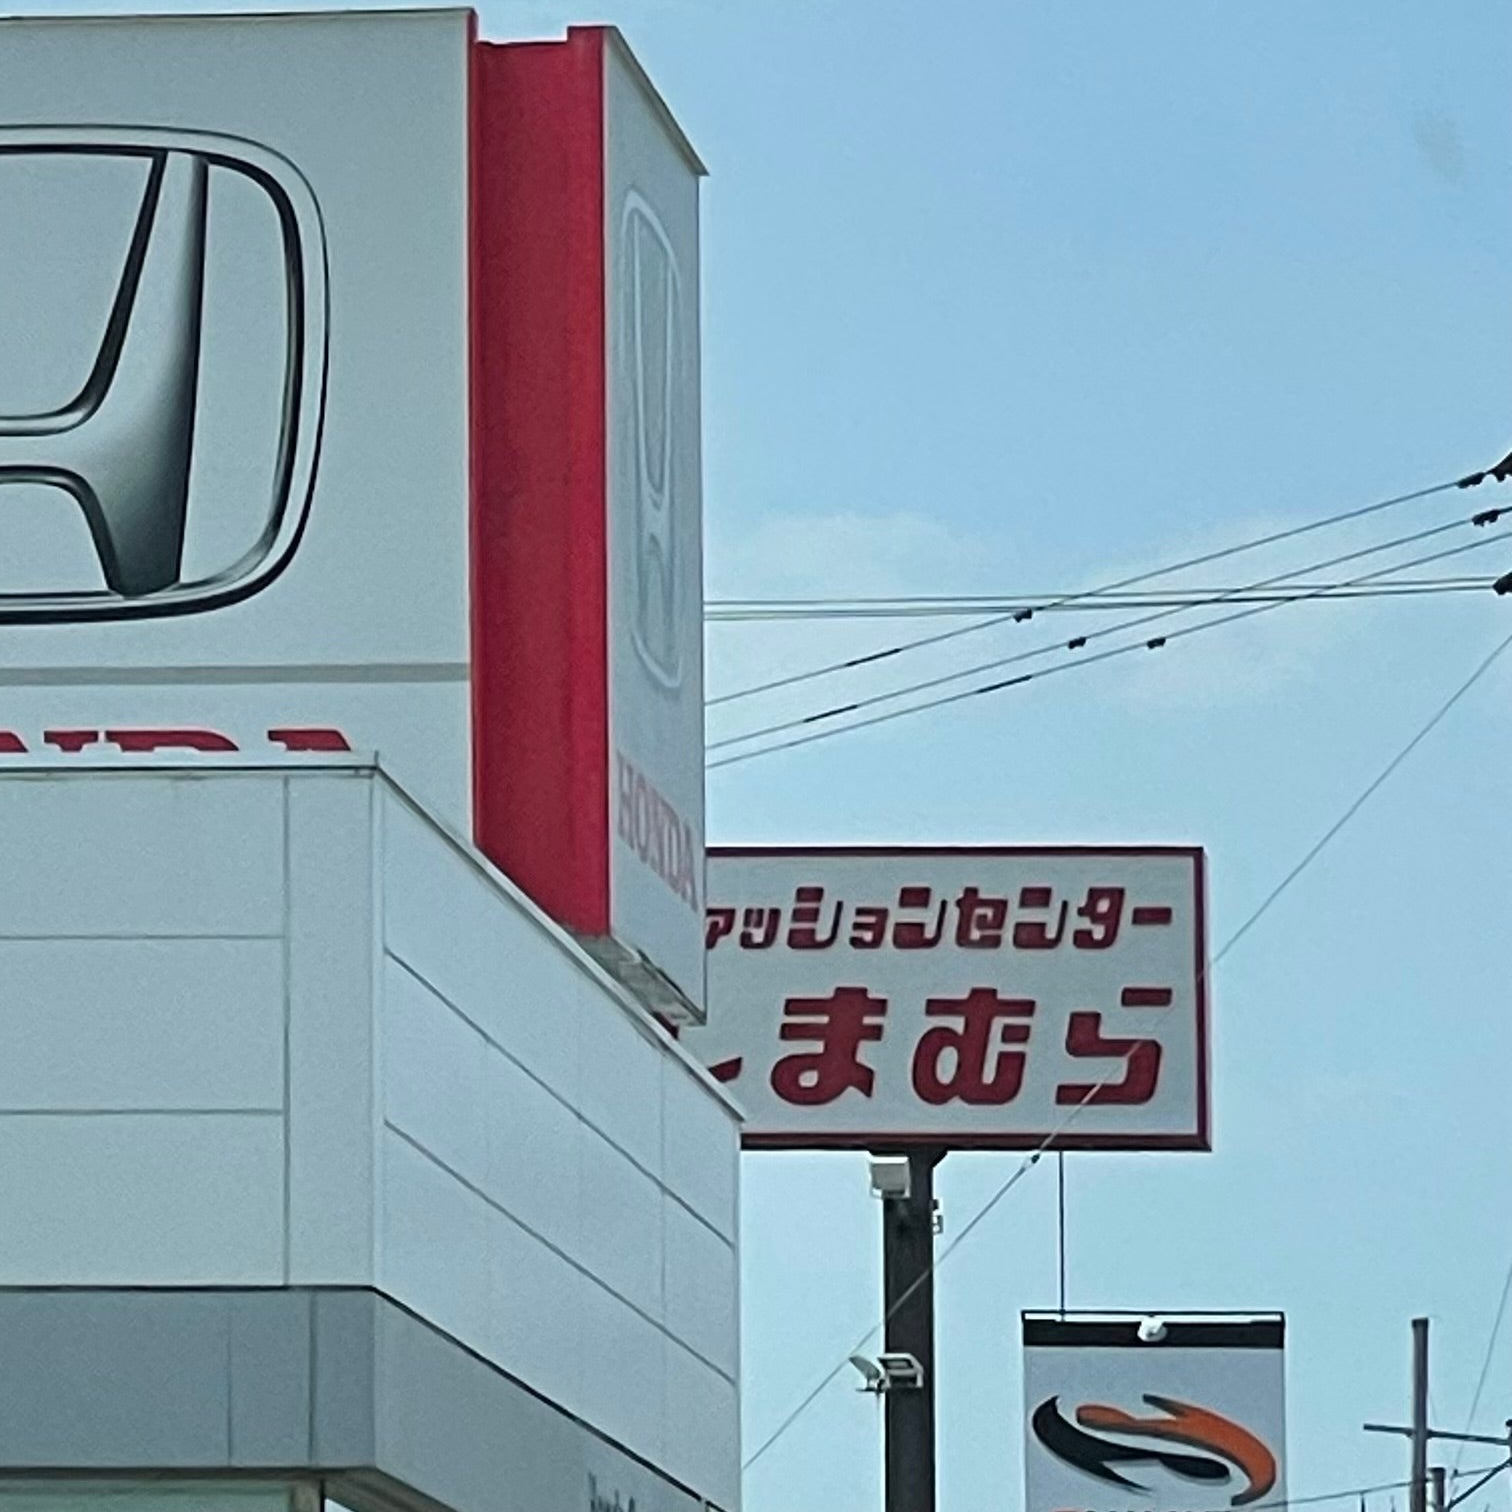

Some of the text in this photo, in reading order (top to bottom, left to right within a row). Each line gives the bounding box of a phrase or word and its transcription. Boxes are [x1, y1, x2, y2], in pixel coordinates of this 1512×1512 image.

[617, 750, 698, 913] HONDA
[708, 986, 1173, 1106] まむら
